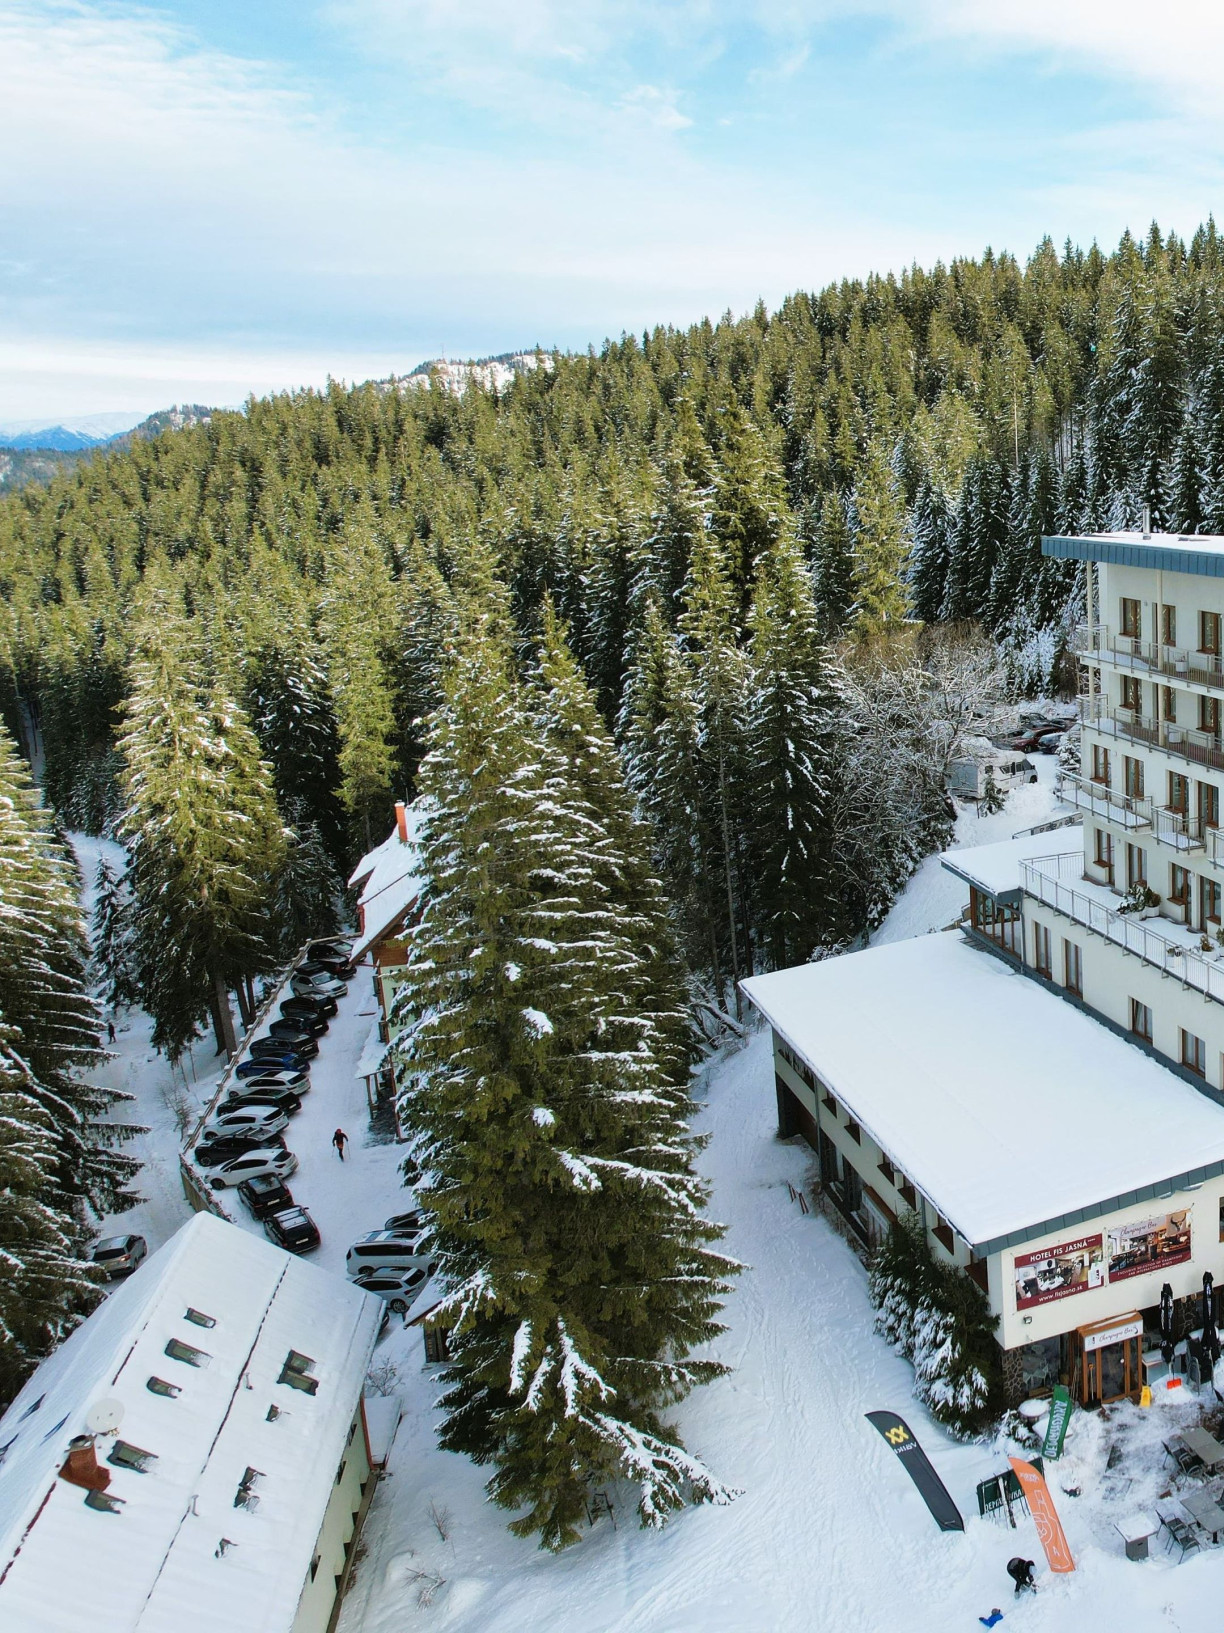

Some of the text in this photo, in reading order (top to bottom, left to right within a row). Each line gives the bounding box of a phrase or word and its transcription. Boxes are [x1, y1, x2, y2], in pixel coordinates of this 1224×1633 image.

[1030, 1238, 1088, 1262] HOTEL FIS JASNÁ
